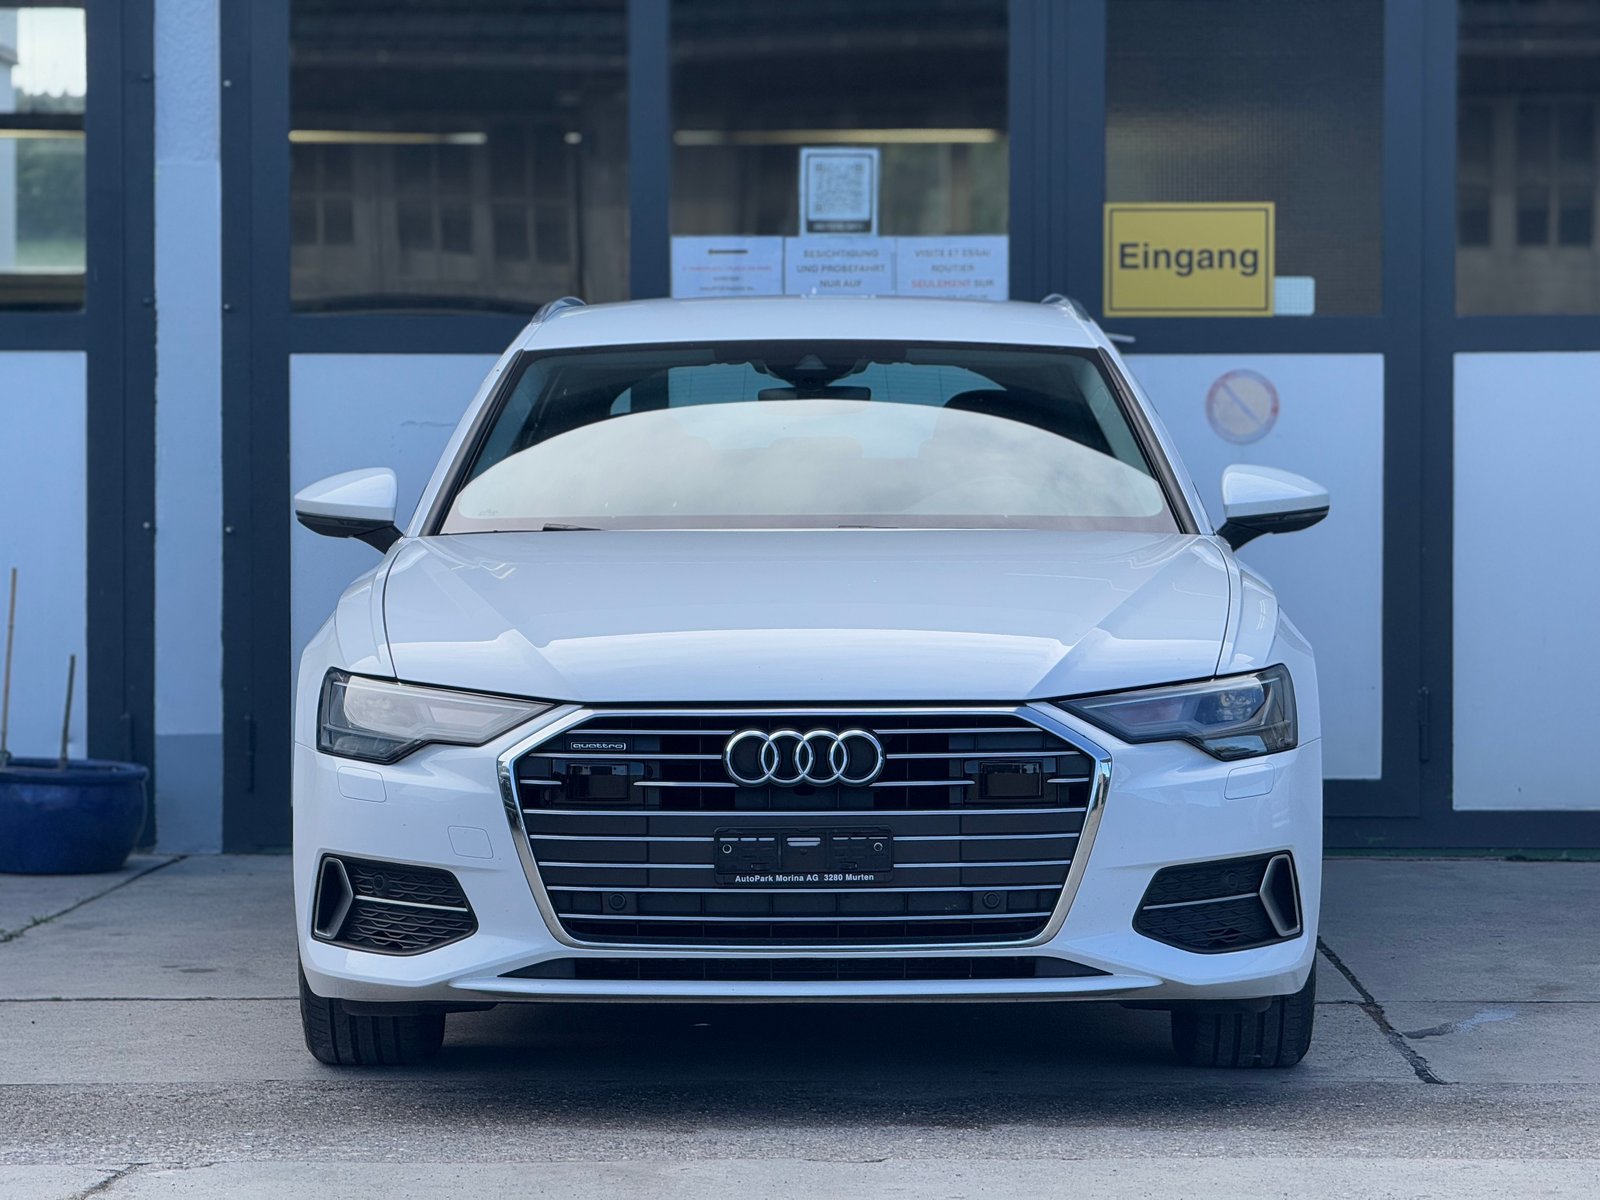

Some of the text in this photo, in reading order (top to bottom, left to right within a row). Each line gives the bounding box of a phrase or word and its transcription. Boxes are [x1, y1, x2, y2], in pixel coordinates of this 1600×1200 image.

[803, 248, 879, 257] BESICHTIGUNG
[1119, 242, 1260, 277] Eingang
[796, 264, 886, 273] UND PROBEFAHRT
[819, 279, 862, 288] NUR AUF
[911, 279, 995, 288] SEULEMENT SUR
[572, 742, 624, 750] quattro
[735, 873, 875, 883] AutoPark Morina AG 3280 Murten
